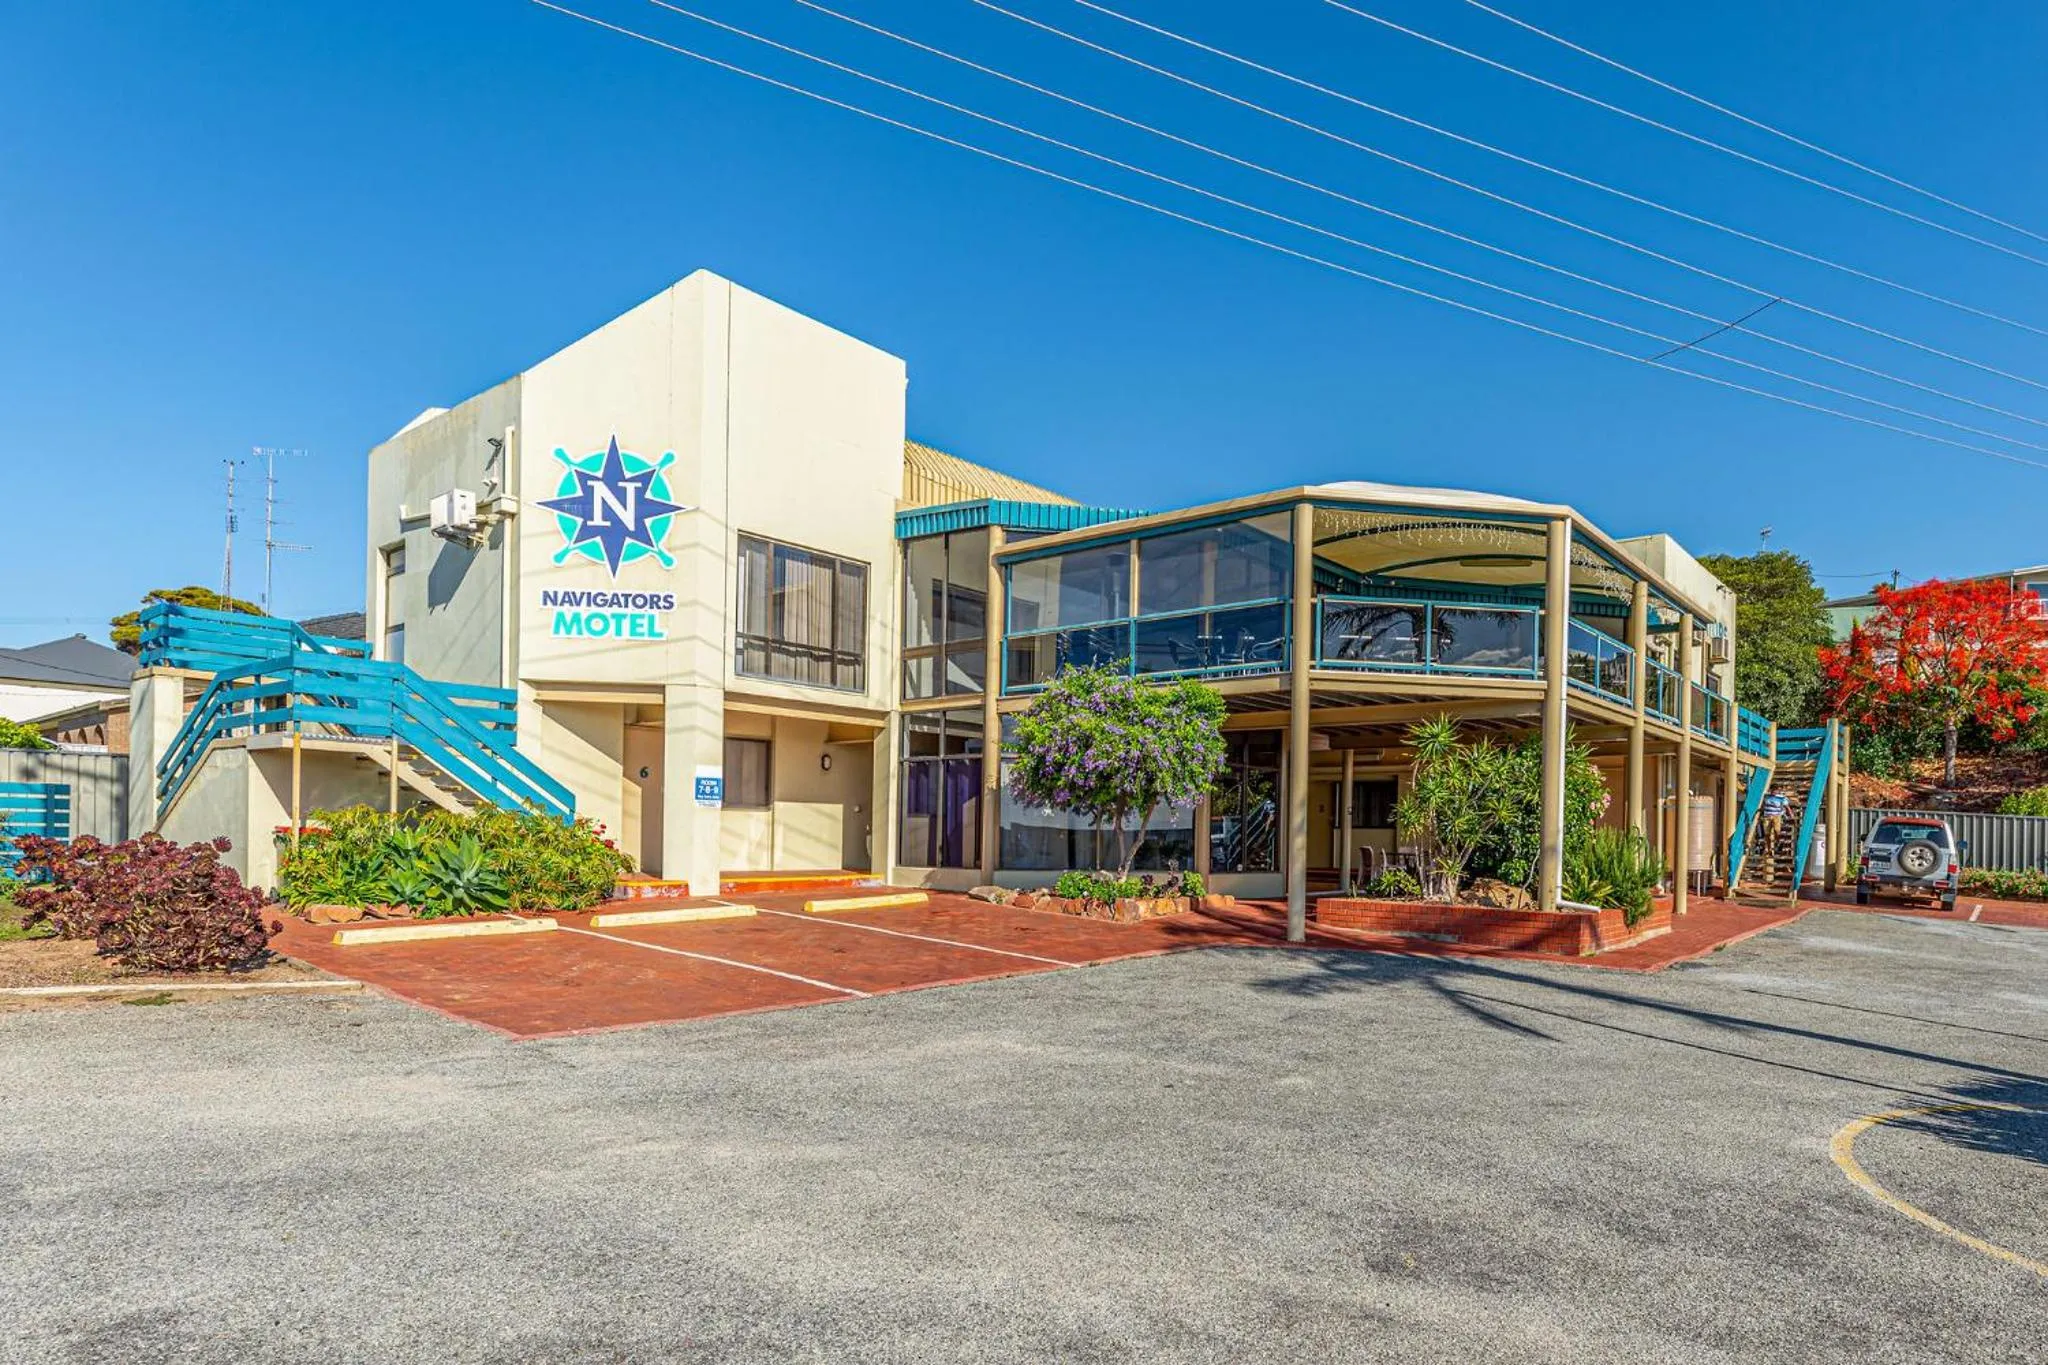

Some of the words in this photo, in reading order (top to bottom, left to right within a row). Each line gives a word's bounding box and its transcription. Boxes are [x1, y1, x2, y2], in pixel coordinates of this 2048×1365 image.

[586, 480, 642, 531] N
[541, 590, 675, 610] NAVIGATORS
[553, 612, 664, 638] MOTEL
[640, 766, 649, 778] 6
